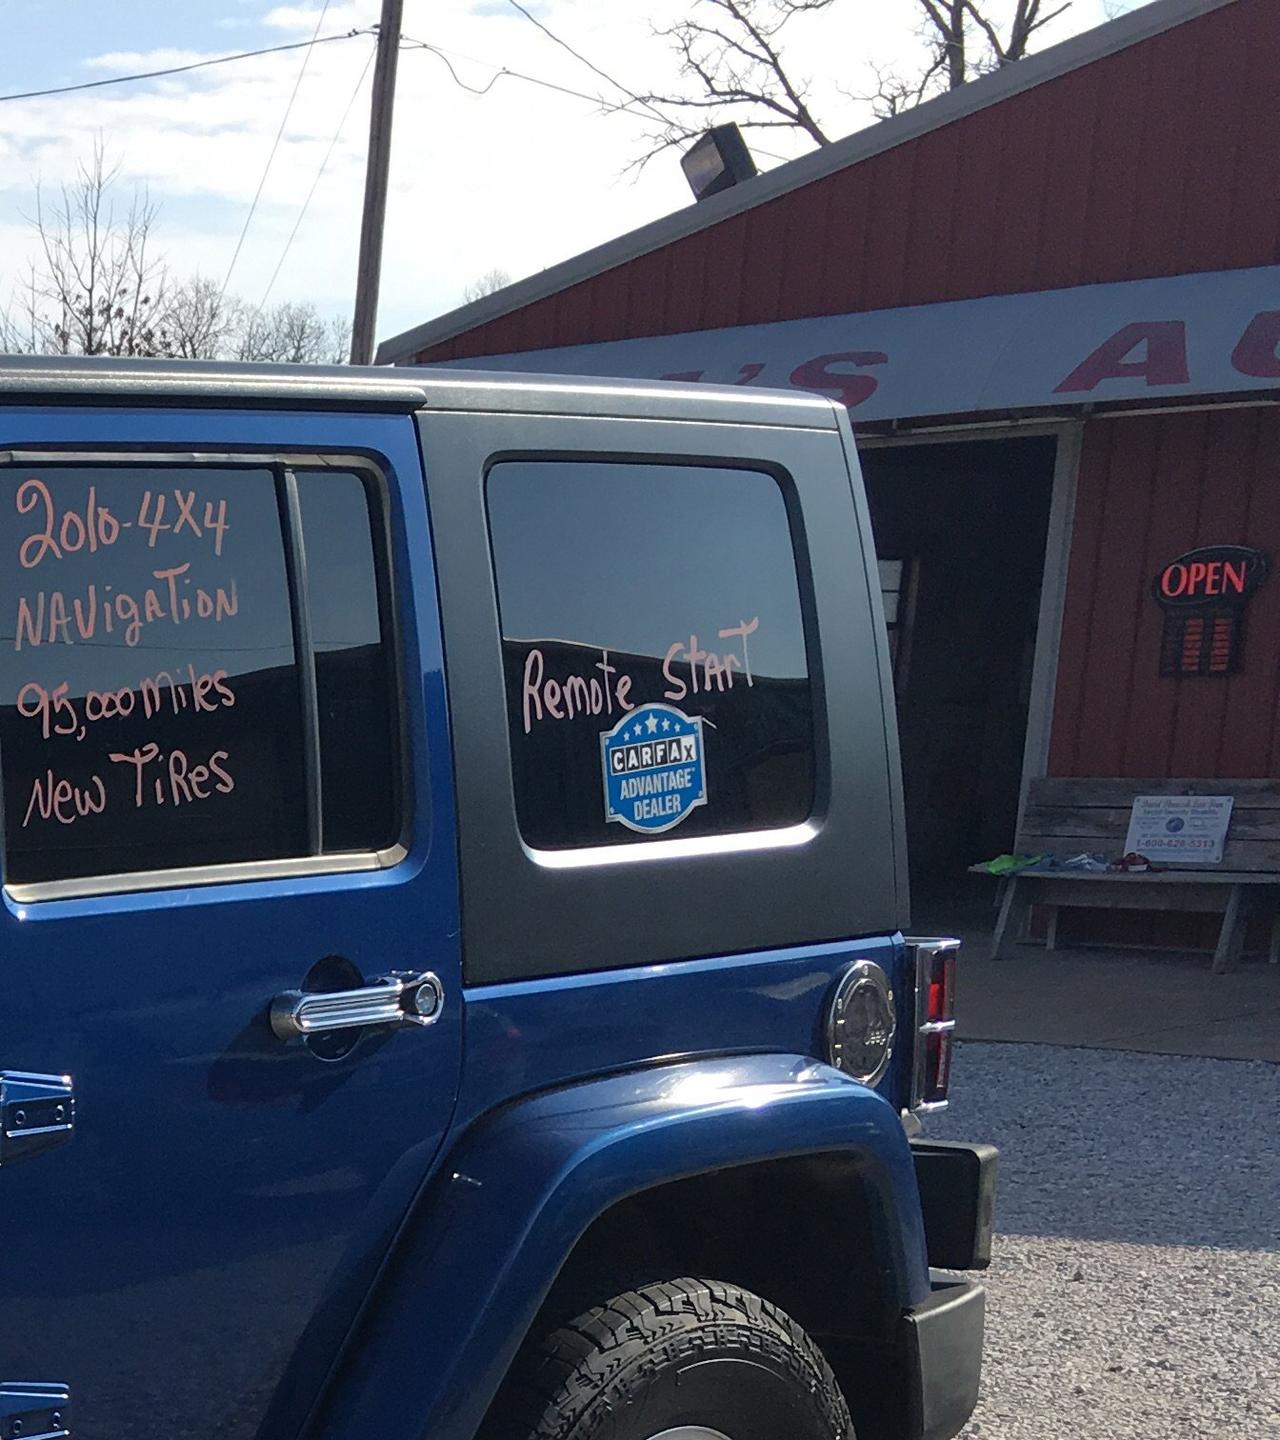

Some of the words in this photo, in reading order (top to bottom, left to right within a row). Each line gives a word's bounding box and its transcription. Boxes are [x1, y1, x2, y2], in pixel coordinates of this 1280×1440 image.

[1161, 561, 1246, 597] OPEN
[523, 649, 635, 734] Remote
[612, 741, 695, 771] CARFAX
[22, 769, 107, 828] New
[620, 768, 694, 800] ADVANTAGE
[633, 794, 681, 821] DEALER
